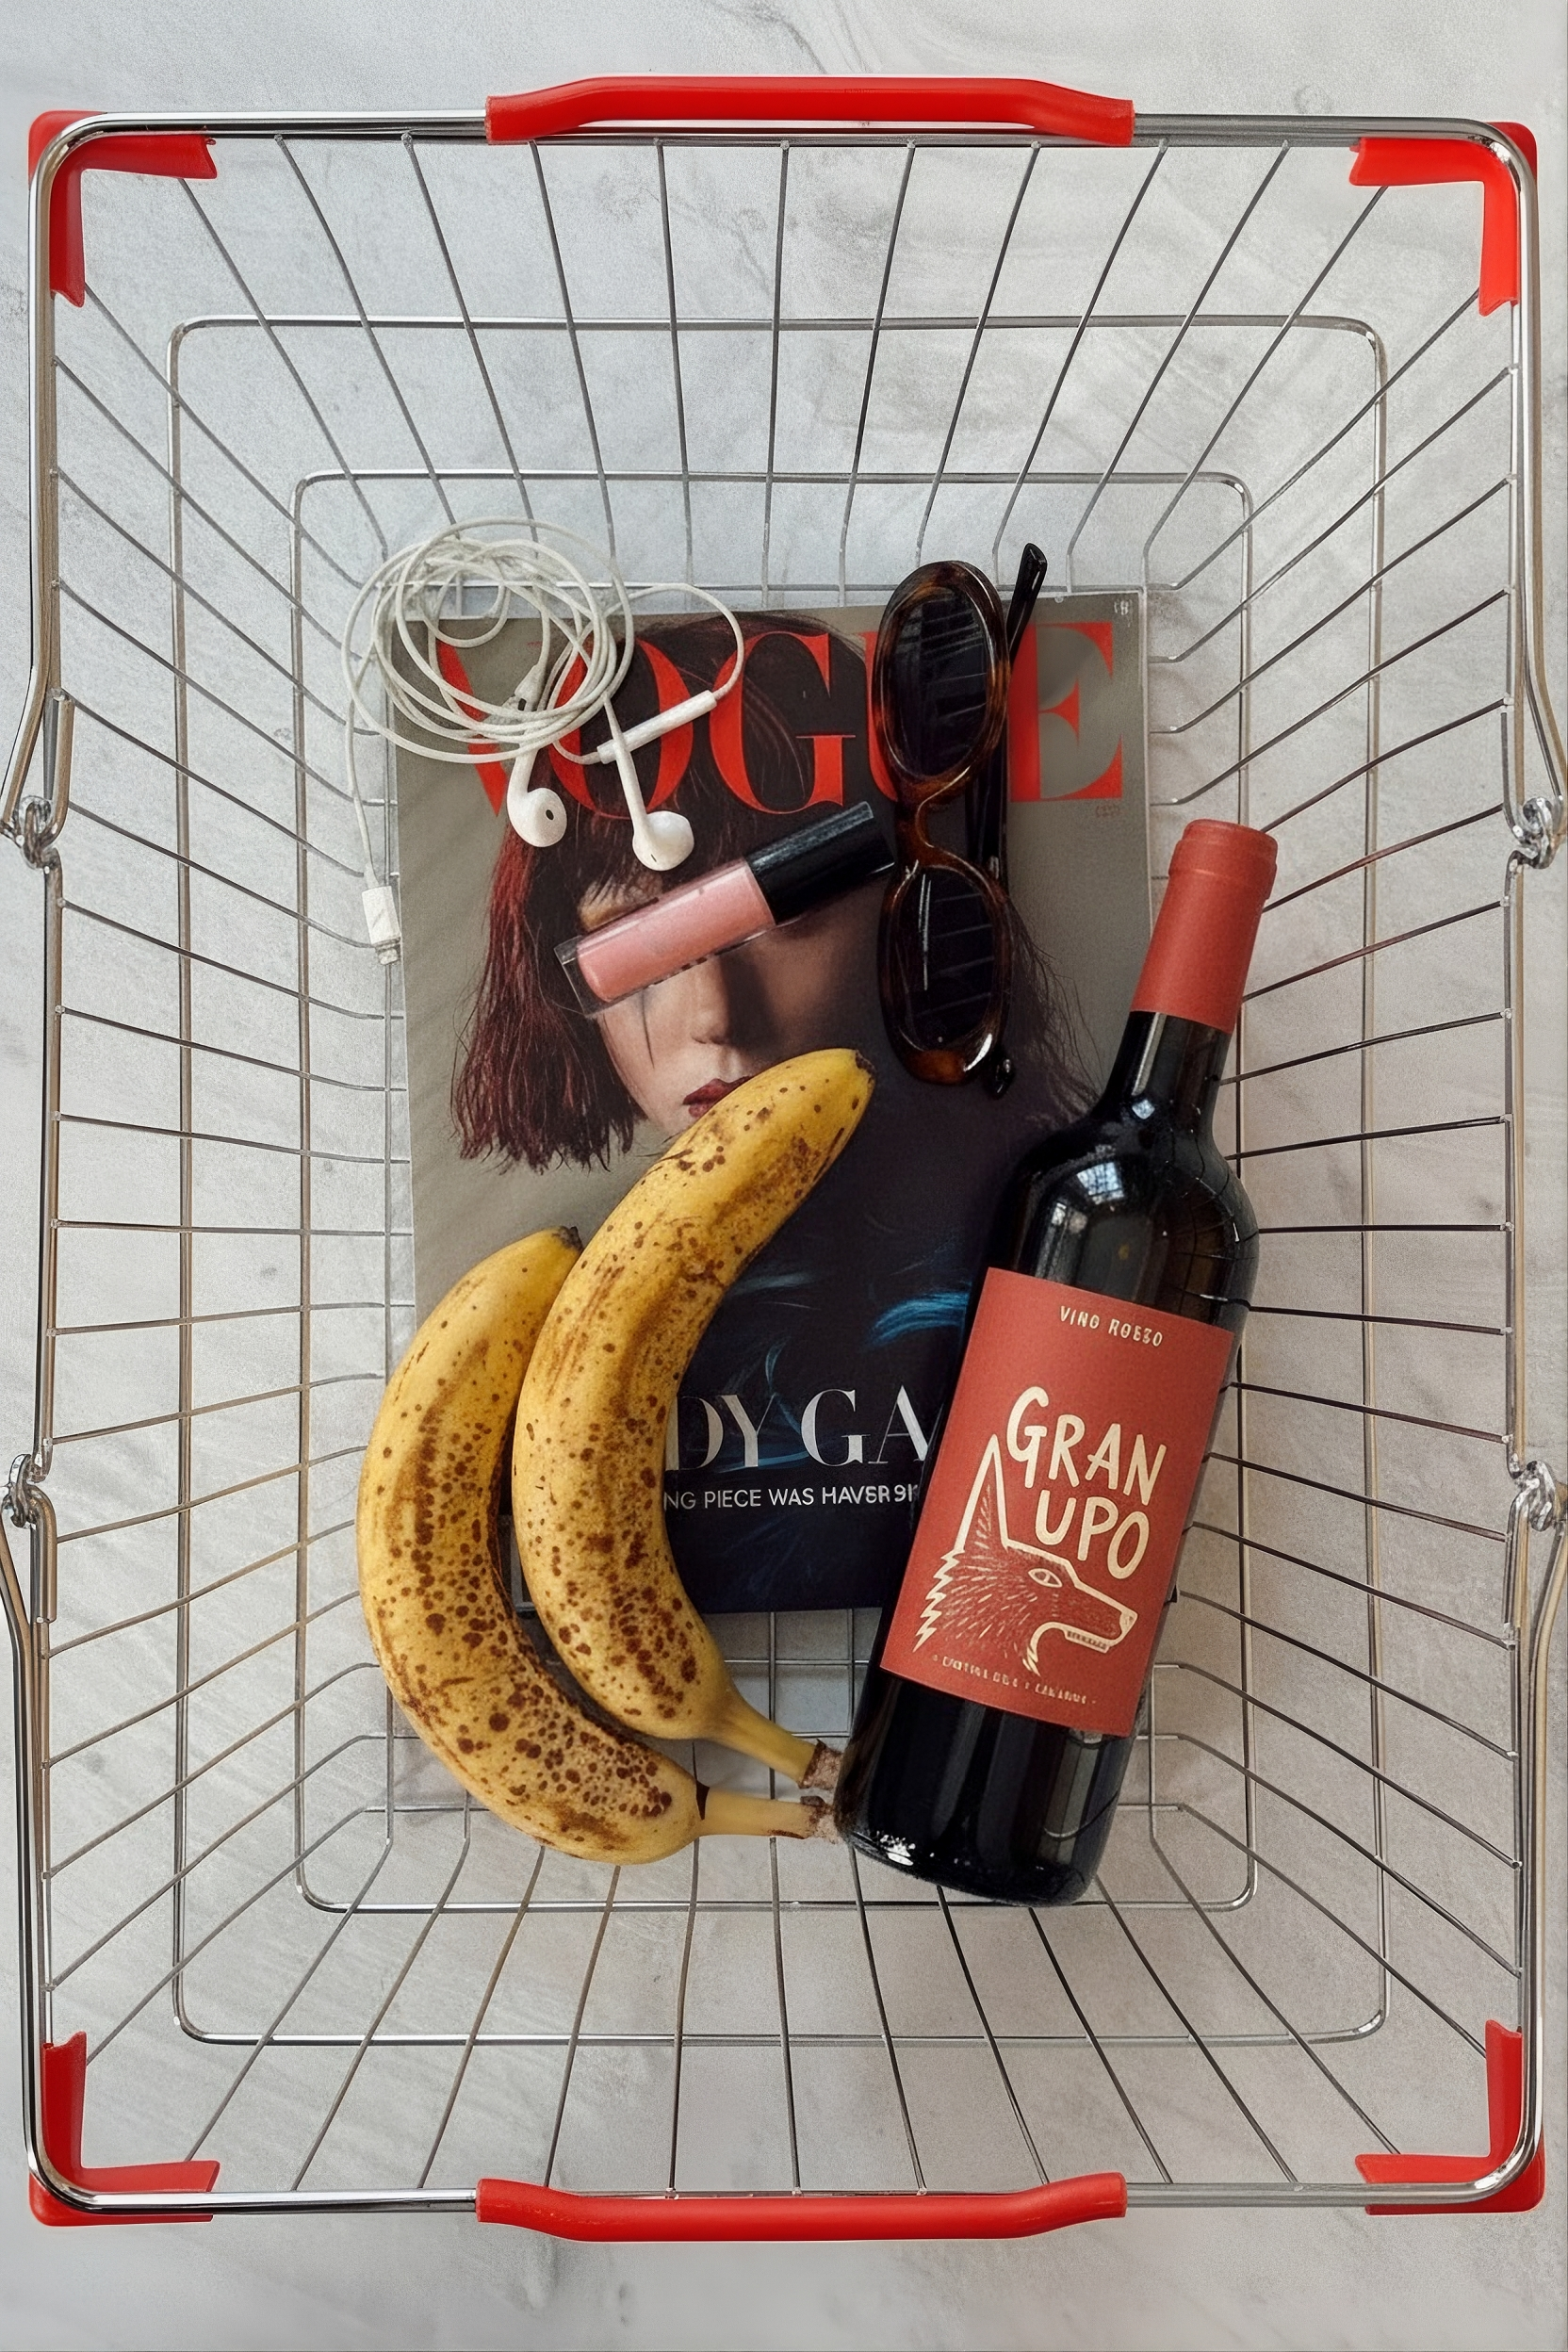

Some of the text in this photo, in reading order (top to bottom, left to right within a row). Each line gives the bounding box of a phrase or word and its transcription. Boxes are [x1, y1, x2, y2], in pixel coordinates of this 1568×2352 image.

[1006, 1385, 1167, 1507] GRAN
[704, 1489, 762, 1509] PIECE
[768, 1487, 815, 1507] WAS
